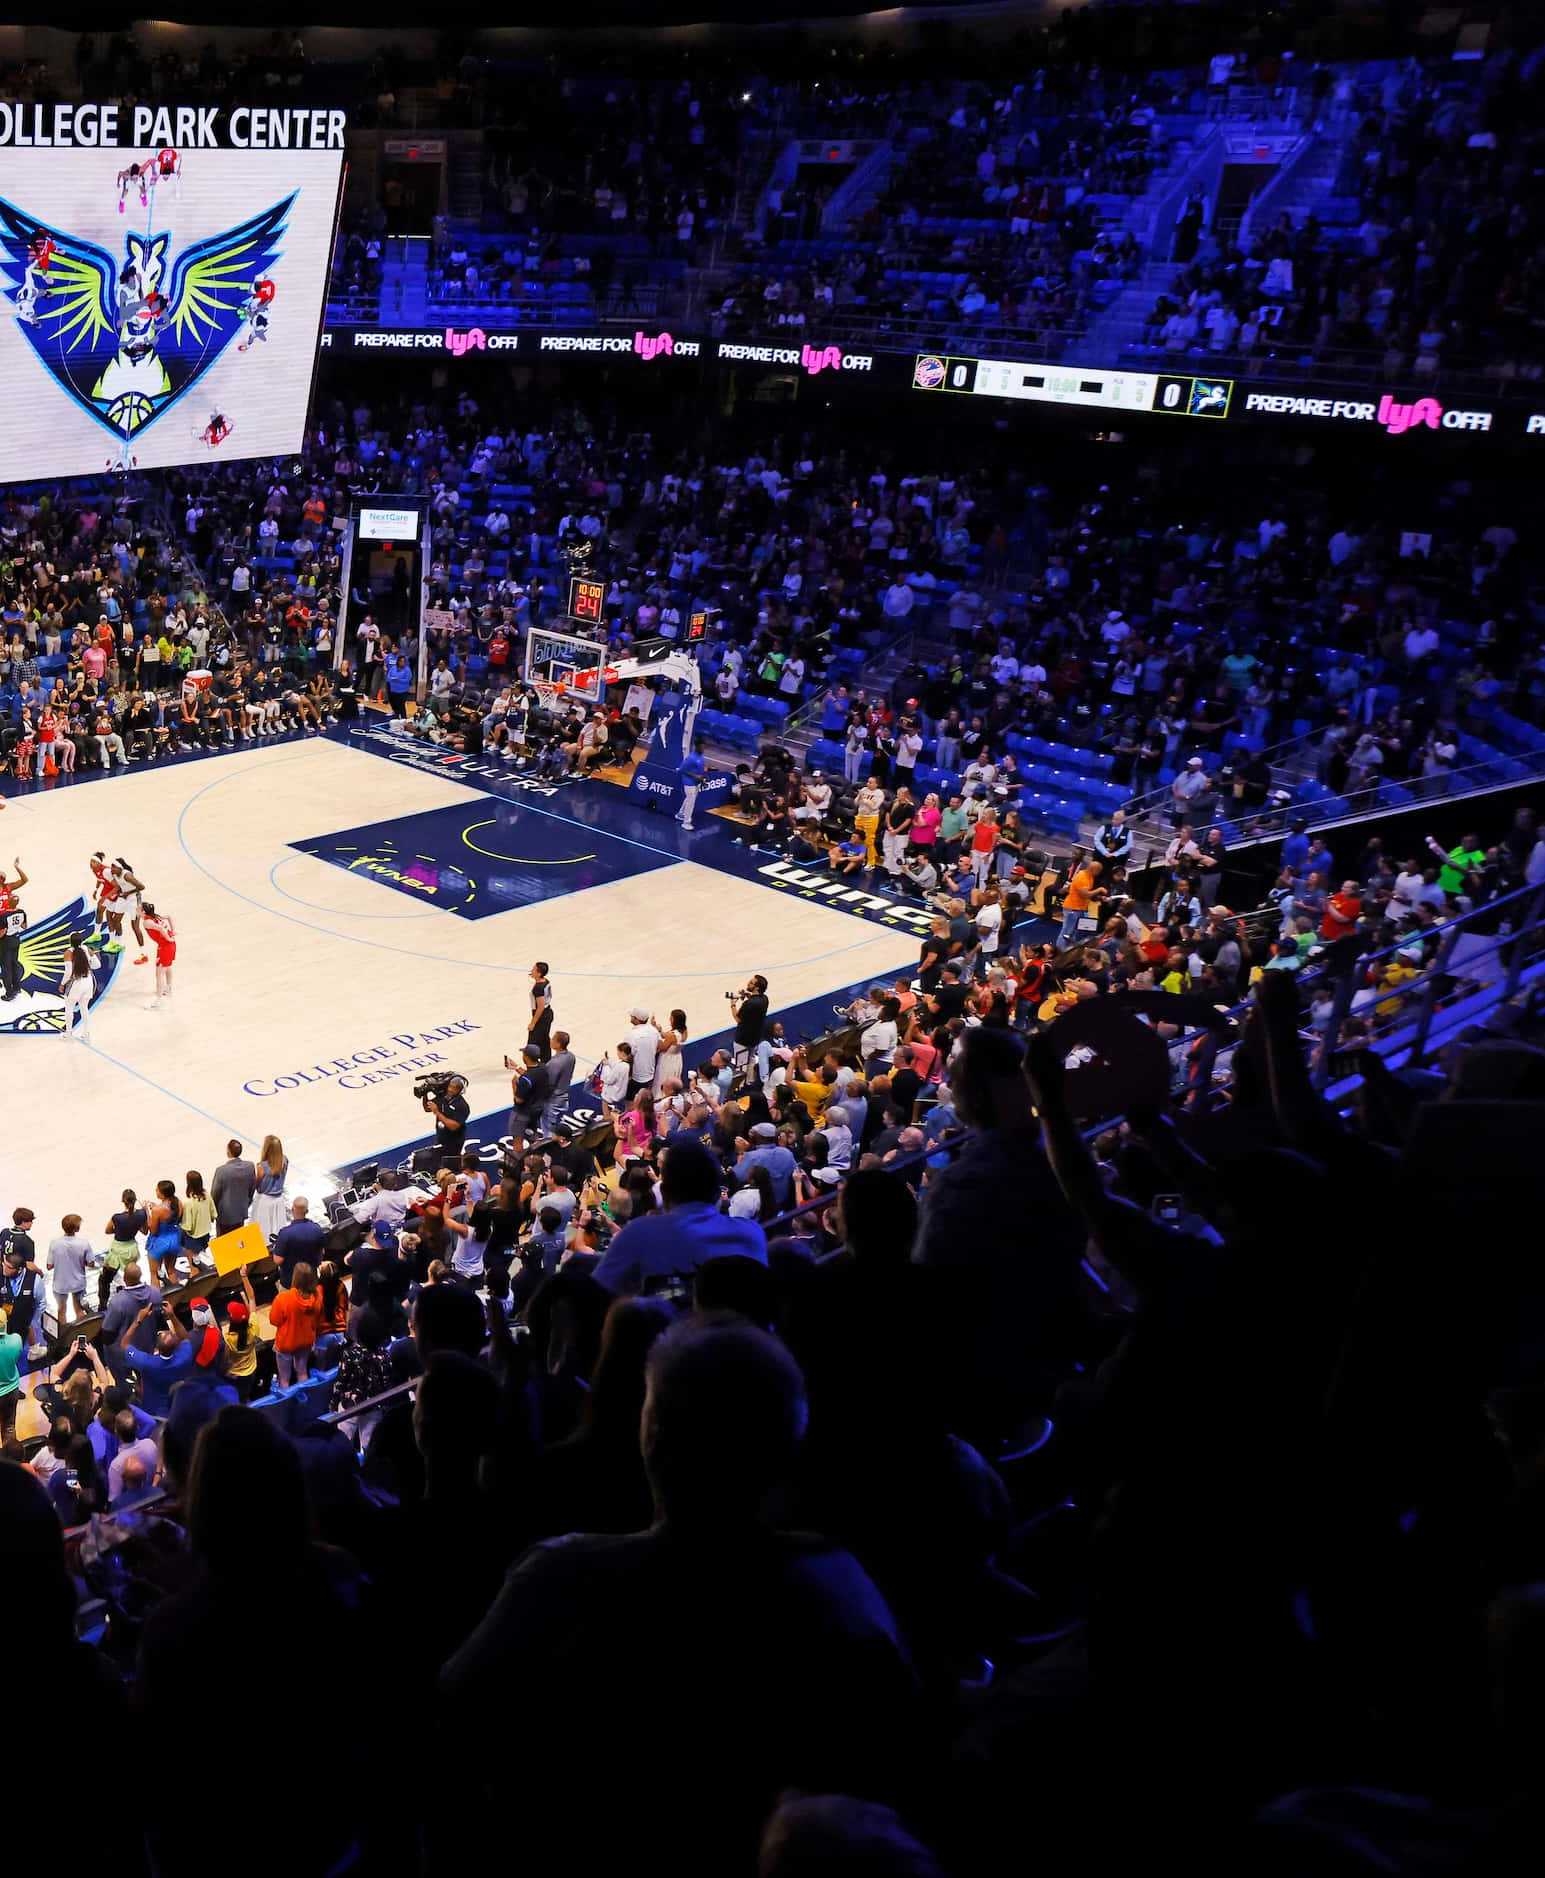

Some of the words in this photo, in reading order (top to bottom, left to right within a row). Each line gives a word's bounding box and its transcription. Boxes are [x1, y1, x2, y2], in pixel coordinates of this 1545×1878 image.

[133, 106, 219, 147] PARK
[229, 107, 347, 148] CENTER
[354, 333, 414, 347] PREPARE
[414, 334, 443, 348] FOR
[444, 327, 487, 356] lyft
[540, 336, 602, 352] PREPARE
[602, 338, 632, 351] FOR
[633, 331, 674, 360] lyft
[718, 343, 772, 362] PREPARE
[772, 348, 800, 364] FOR
[800, 344, 842, 375] lyft
[952, 364, 968, 387] 0
[1162, 383, 1182, 407] 0
[1245, 393, 1332, 417] PREPARE
[1331, 401, 1376, 421] FOR
[1377, 394, 1443, 435] lyft
[576, 595, 599, 617] 24
[460, 761, 560, 797] ULTRA
[649, 781, 674, 797] AT&T
[366, 863, 437, 895] WNBA
[757, 860, 940, 926] WING
[770, 881, 931, 935] DALLAS
[242, 1045, 398, 1097] COLLEGE
[390, 1018, 483, 1051] PARK
[337, 1052, 449, 1090] CENTER
